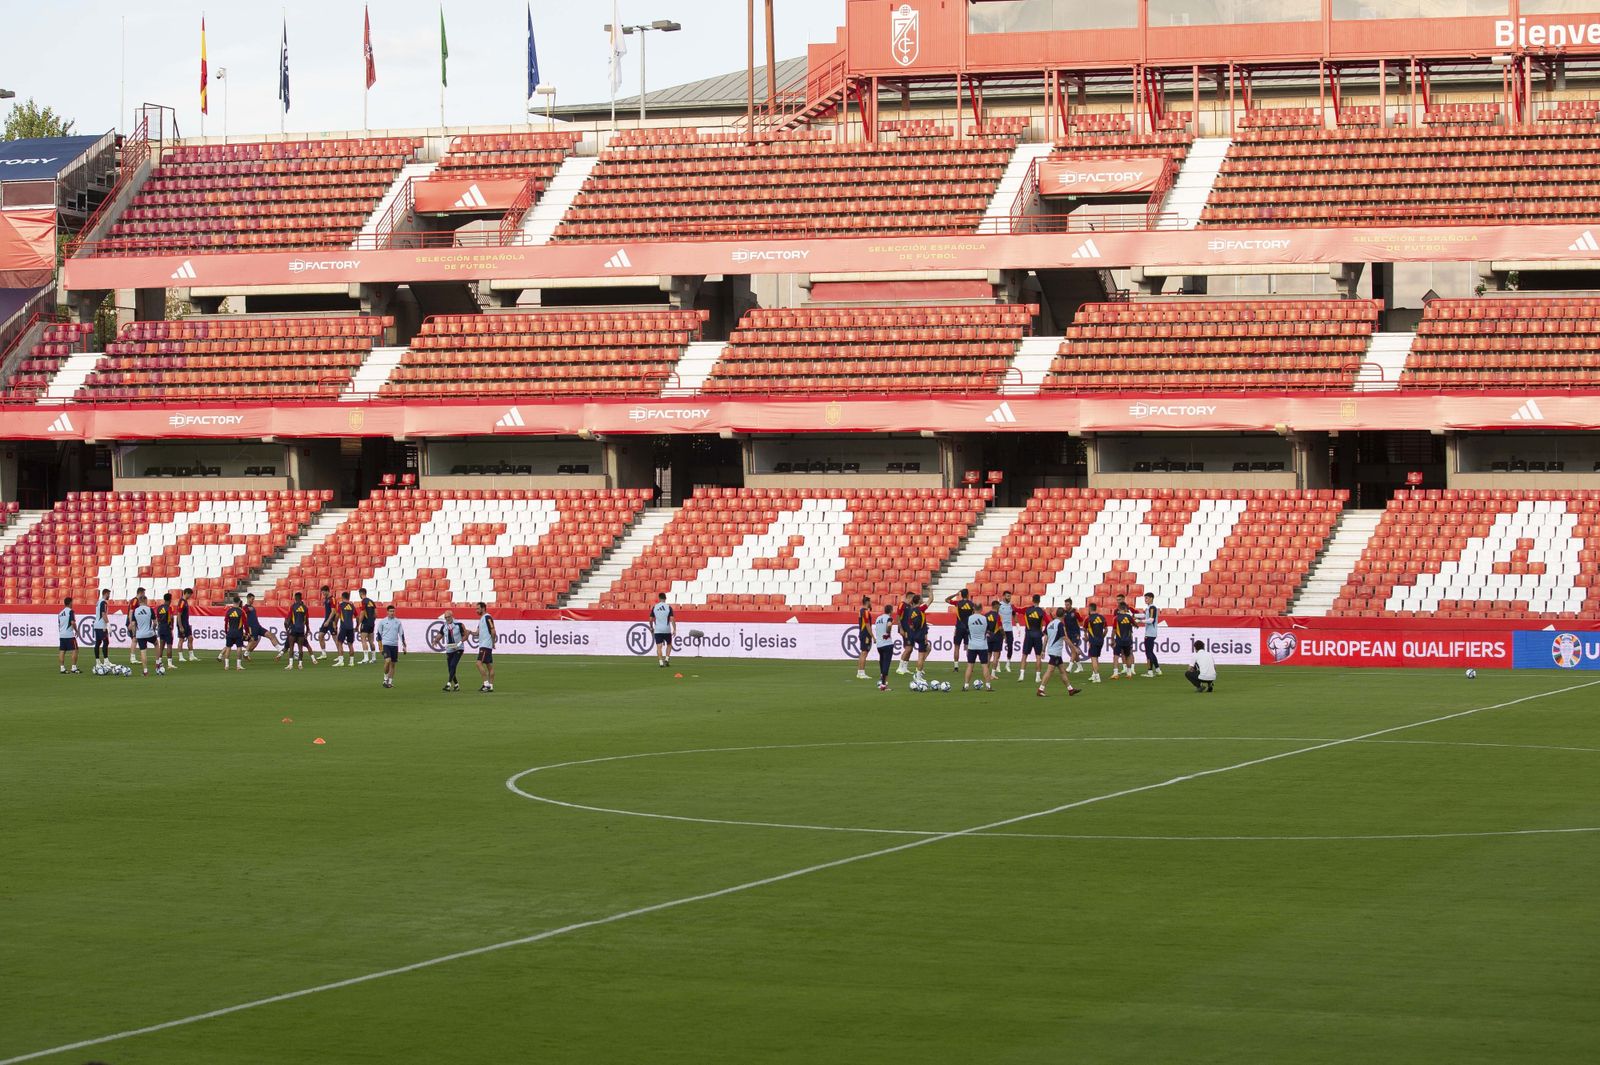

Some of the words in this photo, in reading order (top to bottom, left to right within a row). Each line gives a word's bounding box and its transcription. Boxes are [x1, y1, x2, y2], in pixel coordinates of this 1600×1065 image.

[1495, 17, 1600, 47] Bienve
[1078, 172, 1143, 183] FACTORY
[1227, 240, 1290, 249] FACTORY
[749, 250, 810, 260] FACTORY
[305, 261, 361, 271] FACTORY
[648, 409, 711, 419] FACTORY
[1149, 406, 1217, 416] FACTORY
[186, 415, 244, 425] FACTORY
[1301, 640, 1396, 657] EUROPEAN
[1402, 641, 1506, 658] QUALIFIERS
